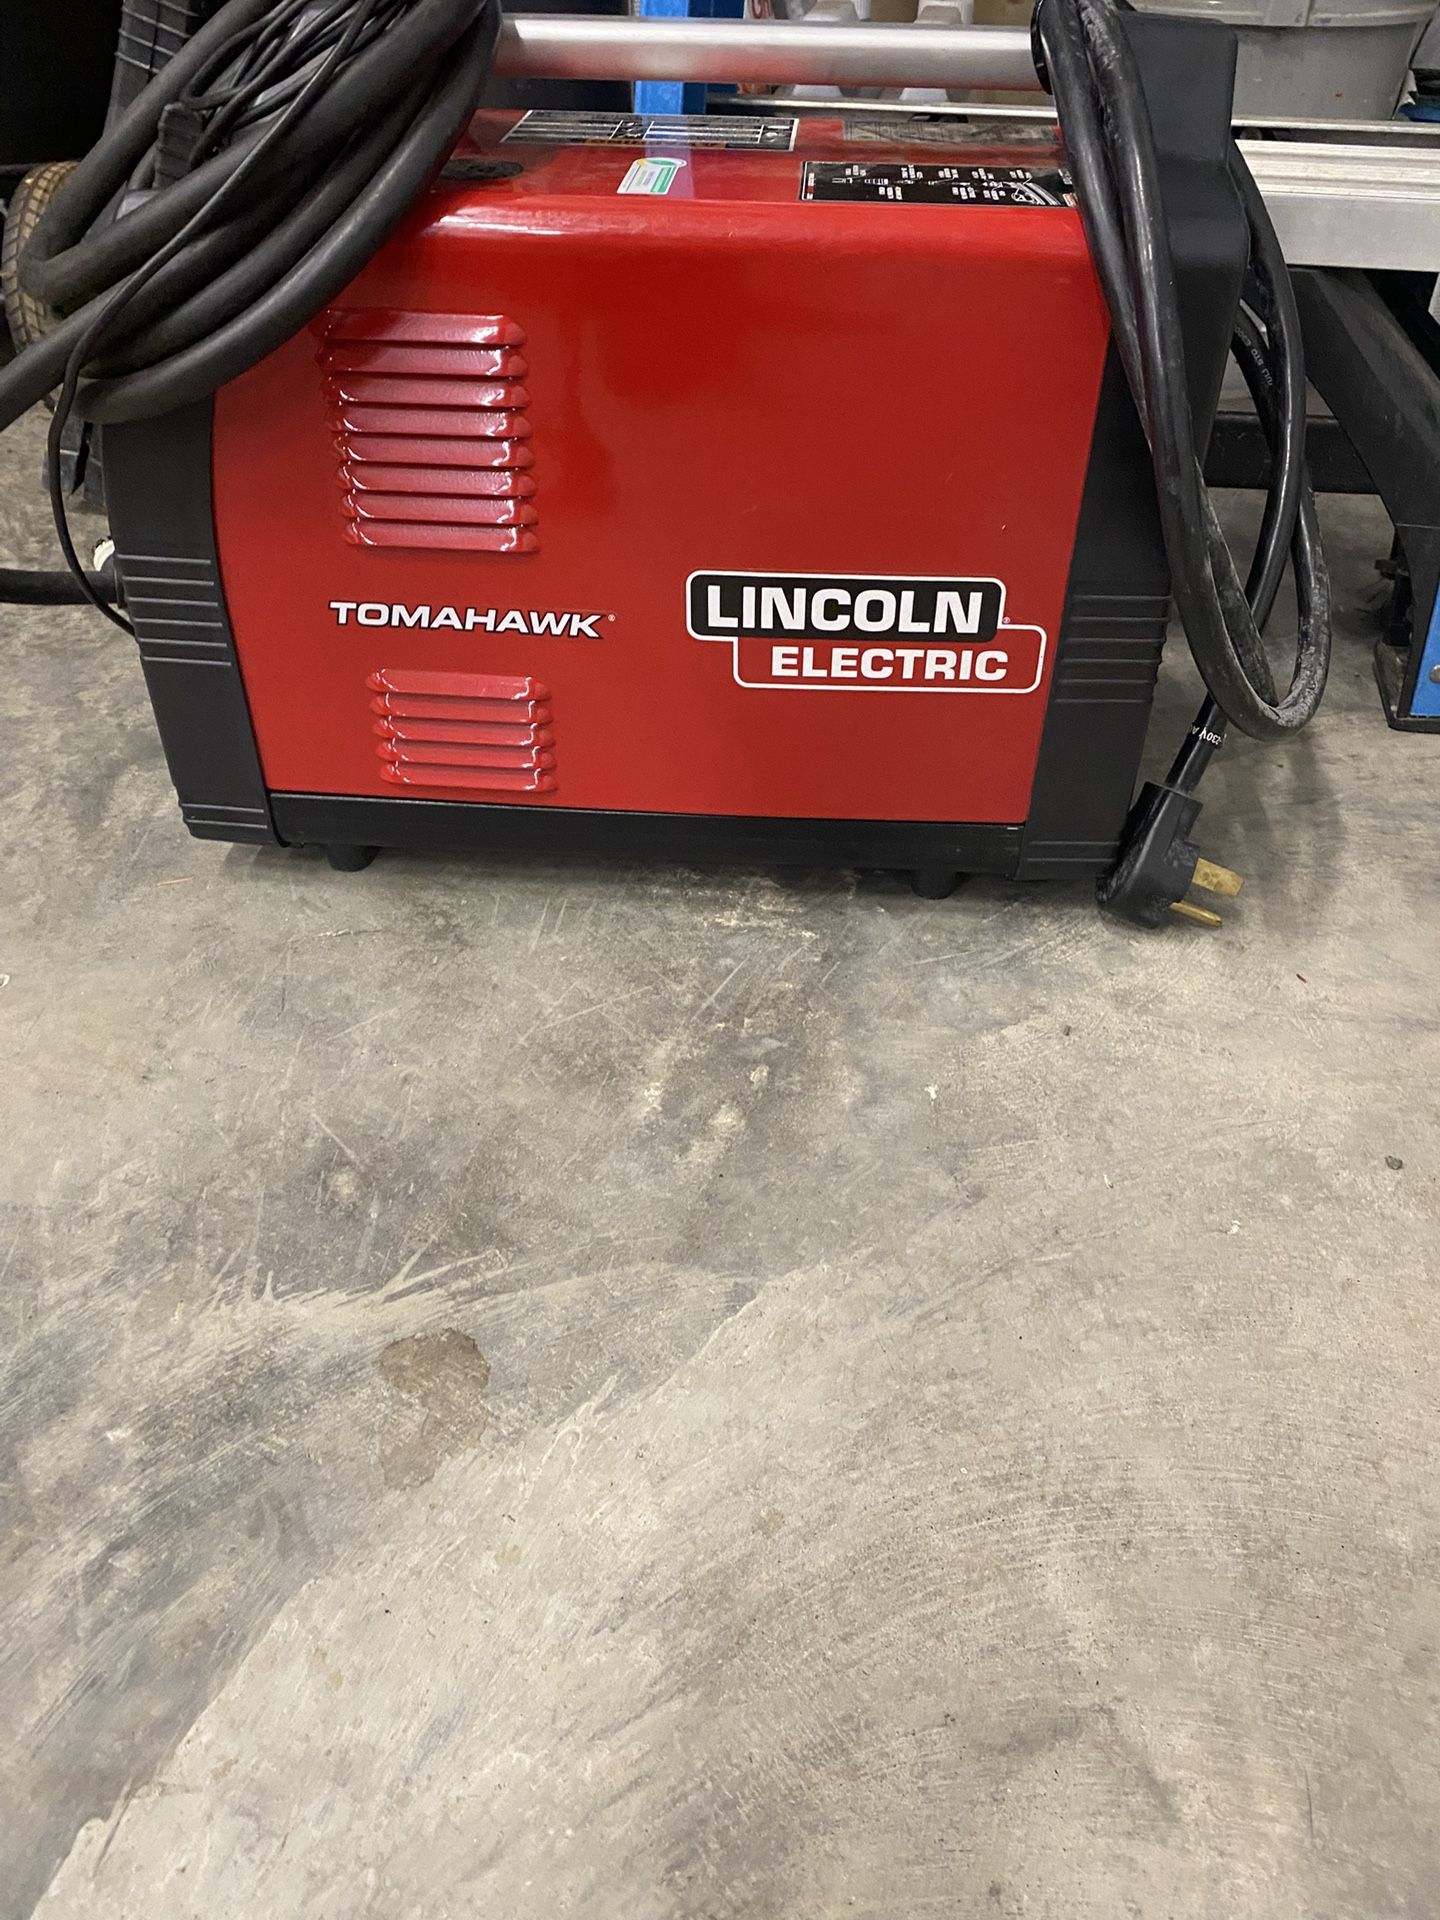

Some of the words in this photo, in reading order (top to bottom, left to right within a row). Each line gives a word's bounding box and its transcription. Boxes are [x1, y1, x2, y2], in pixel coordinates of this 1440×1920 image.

[329, 601, 601, 638] TOMAHAWK
[707, 585, 983, 634] LINCOLN
[771, 645, 1008, 681] ELECTRIC
